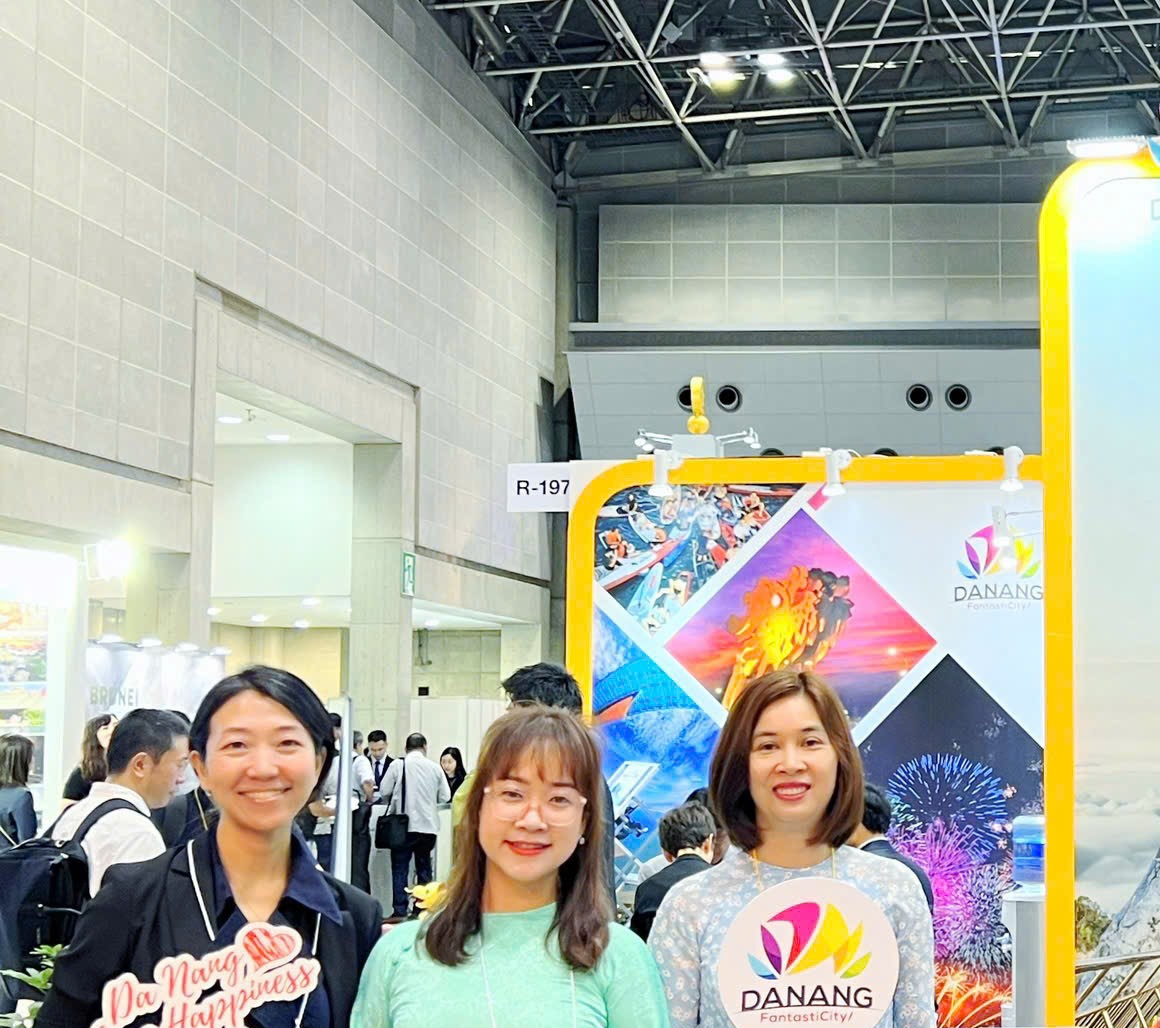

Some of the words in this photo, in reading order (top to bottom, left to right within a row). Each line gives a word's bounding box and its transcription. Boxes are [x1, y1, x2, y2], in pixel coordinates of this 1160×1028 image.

[517, 480, 569, 495] R-197
[954, 584, 1044, 601] DANANG
[110, 980, 157, 1024] Da
[162, 950, 246, 998] Nang
[741, 985, 873, 1012] DANANG
